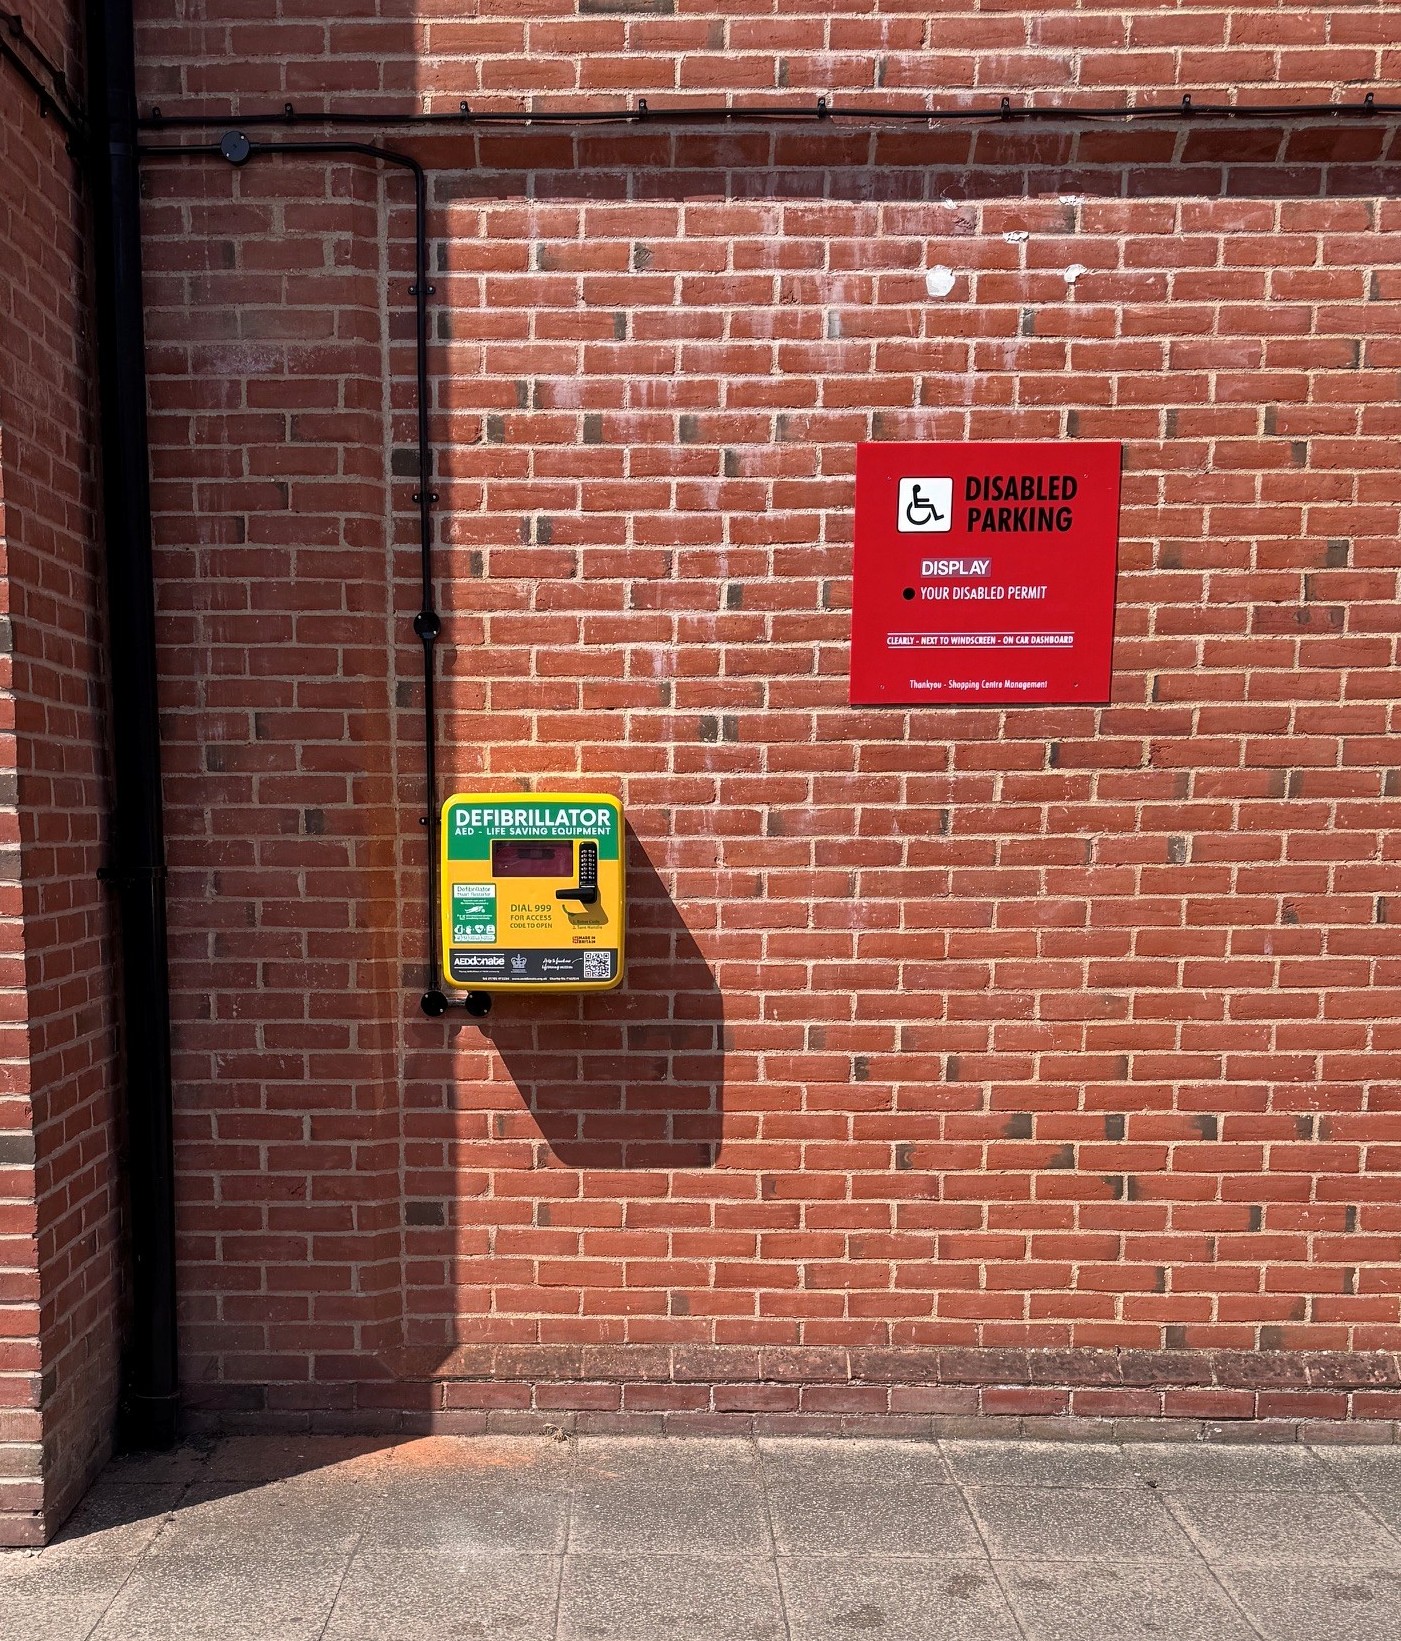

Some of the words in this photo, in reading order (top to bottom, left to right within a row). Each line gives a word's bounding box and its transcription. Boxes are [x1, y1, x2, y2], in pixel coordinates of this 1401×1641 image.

[965, 475, 1078, 501] DISABLED
[967, 506, 1073, 532] PARKING
[921, 560, 990, 576] DISPLAY
[920, 586, 949, 600] YOUR
[1008, 585, 1047, 600] PERMIT
[886, 636, 914, 645] CLEARLY
[921, 636, 938, 645] NEXT
[940, 636, 949, 645] TO
[951, 636, 996, 645] WINDSCREEN
[1002, 636, 1014, 644] ON
[1015, 636, 1029, 644] CAR
[1031, 635, 1074, 644] DASHBOARD
[909, 679, 942, 690] Thankyou
[948, 679, 980, 690] Shopping
[981, 679, 1003, 689] Centre
[1004, 679, 1048, 690] Management
[455, 808, 611, 827] DEFIBRILLATOR
[455, 827, 475, 836] AED
[486, 827, 506, 836] LIFE
[509, 827, 548, 836] SAVING
[551, 827, 611, 836] EQUIPMENT
[510, 903, 532, 912] DIAL
[534, 903, 552, 912] 999
